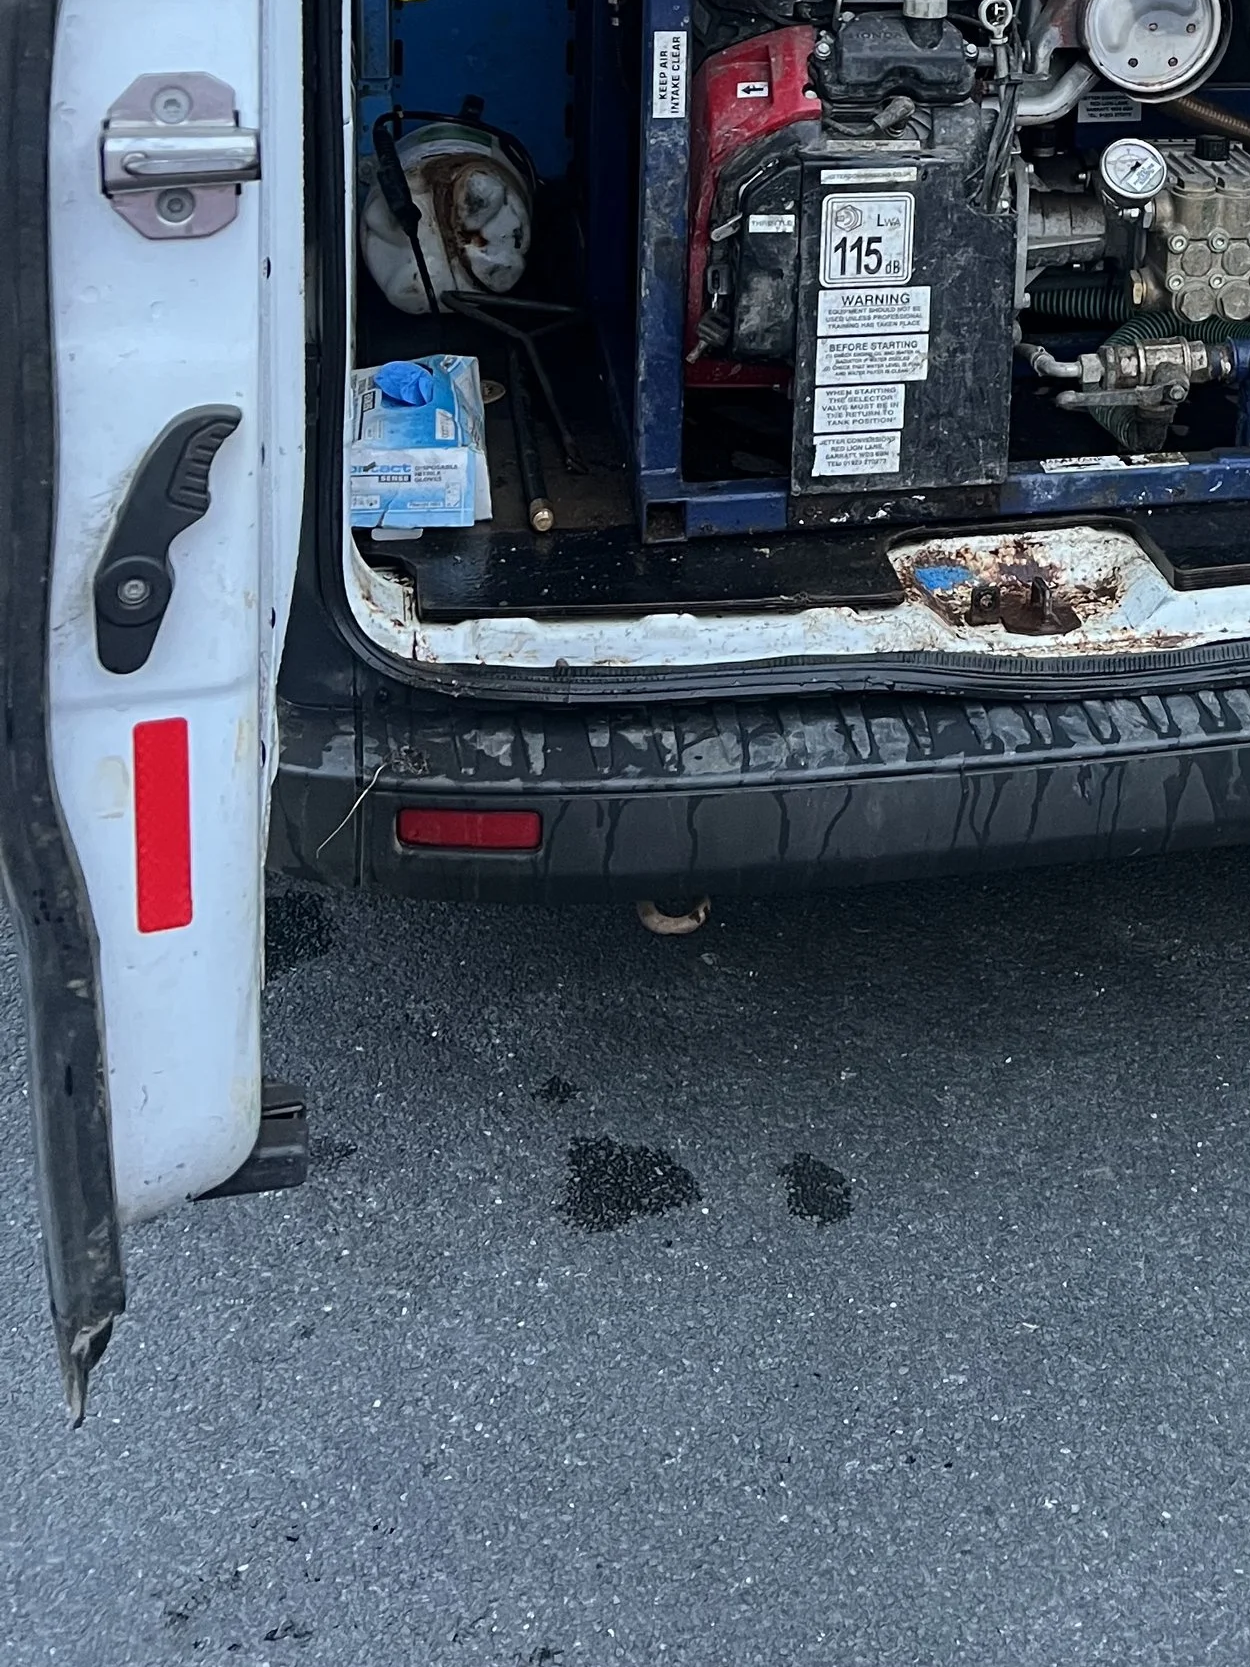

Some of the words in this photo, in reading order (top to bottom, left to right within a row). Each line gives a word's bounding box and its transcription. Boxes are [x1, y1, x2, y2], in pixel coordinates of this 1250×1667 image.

[671, 36, 681, 71] CLEAR
[659, 50, 668, 69] AIR
[658, 71, 668, 100] KEEP
[670, 74, 680, 114] INTAKE
[833, 235, 883, 276] 115
[885, 259, 901, 275] dB
[841, 292, 911, 306] WARNING
[828, 307, 867, 315] EQUIPMENT
[872, 313, 923, 321] PROFESSIONAL
[827, 322, 860, 330] TRAINING
[828, 342, 869, 353] BEFORE
[870, 340, 918, 351] STARTING
[854, 387, 897, 395] STARTING
[847, 394, 893, 403] SELECTOR
[821, 404, 848, 412] VALVE
[849, 402, 875, 410] MUST
[827, 419, 850, 427] TANK
